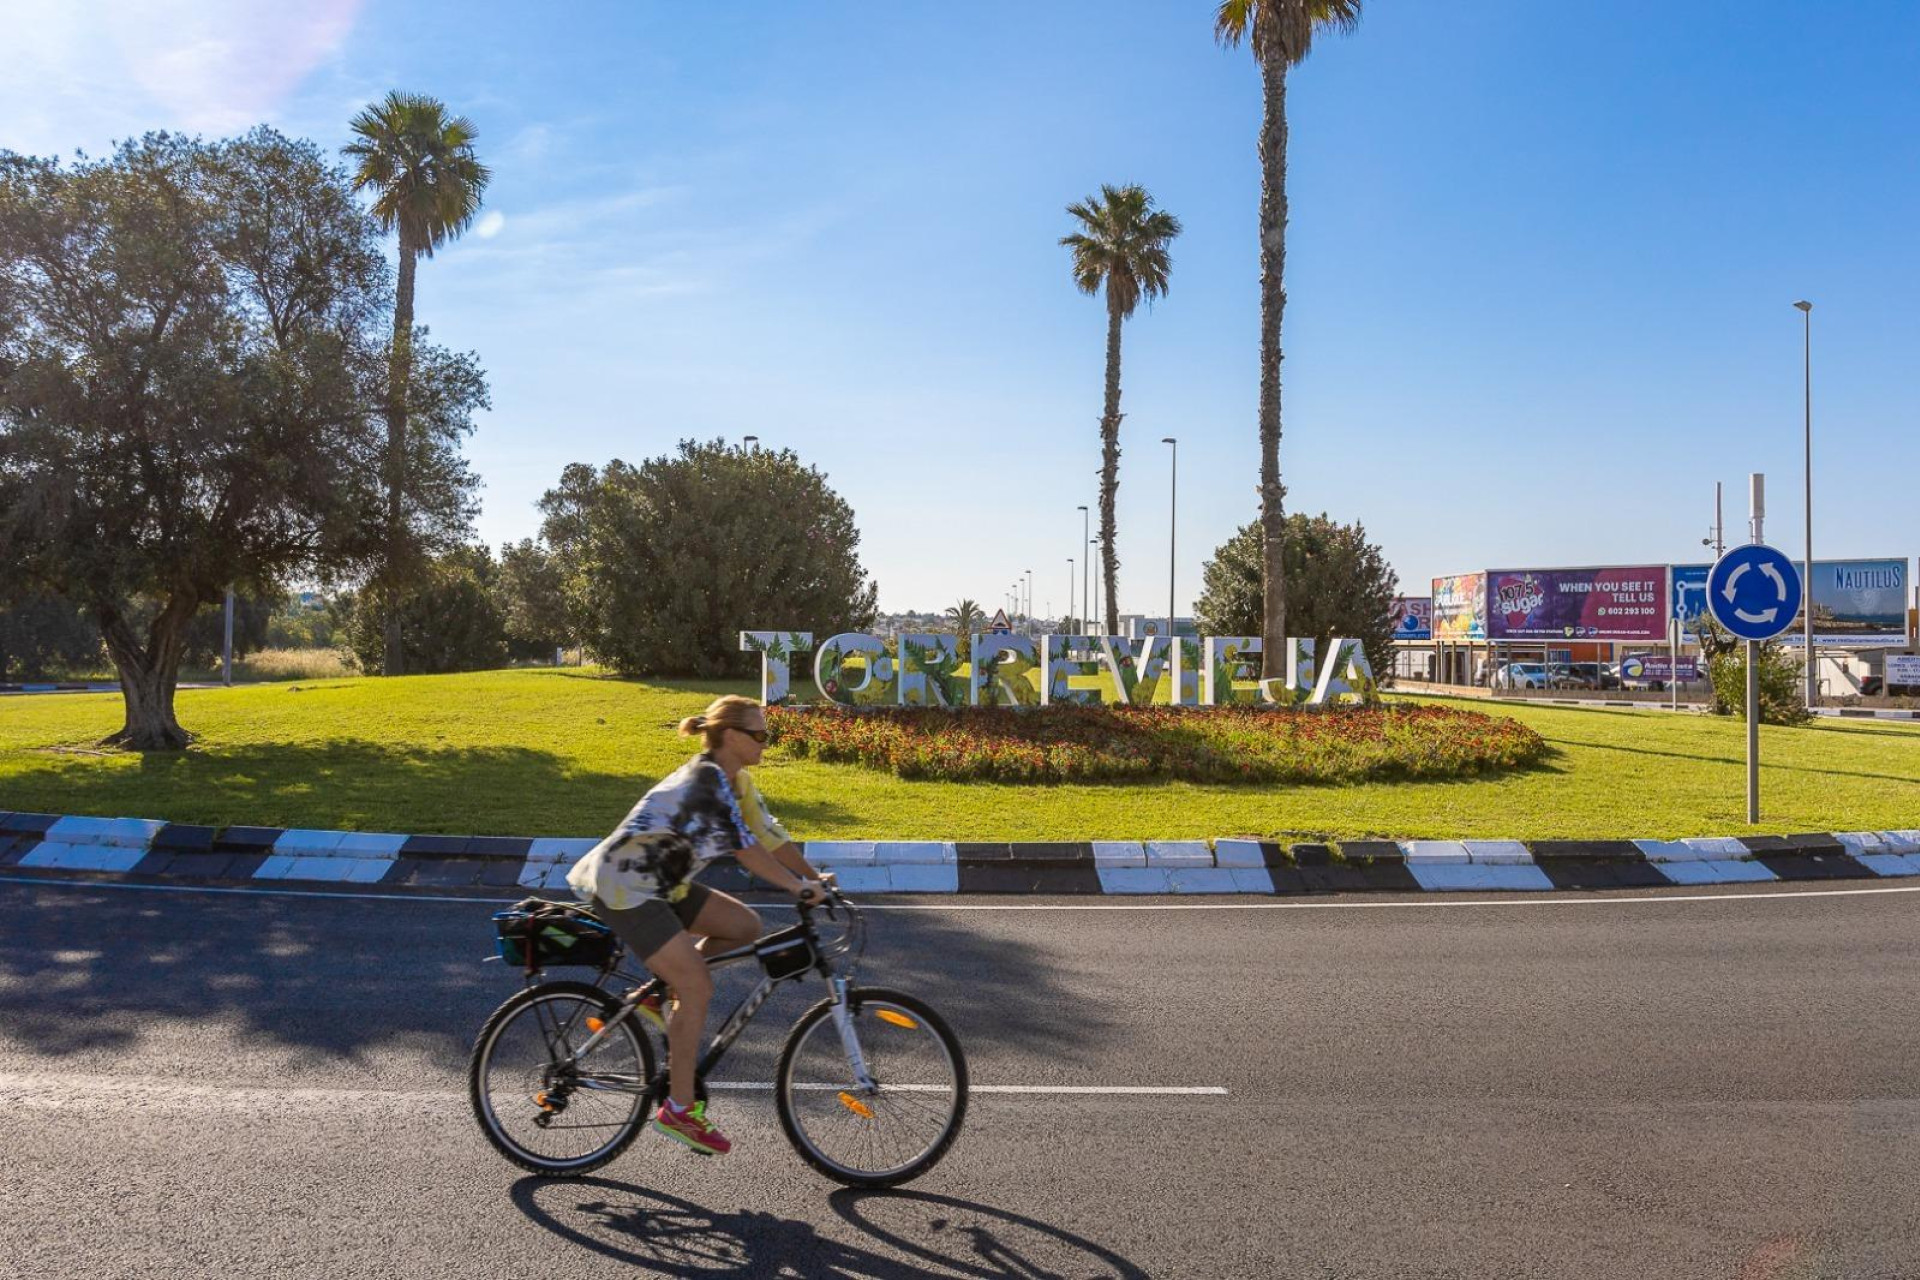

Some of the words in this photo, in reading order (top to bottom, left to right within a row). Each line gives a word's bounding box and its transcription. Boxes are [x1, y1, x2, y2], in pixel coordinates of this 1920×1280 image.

[1836, 566, 1901, 589] NAUTILUS
[1559, 582, 1592, 592] WHEN
[1595, 582, 1618, 592] YOU
[1622, 581, 1641, 591] SEE
[1644, 581, 1654, 591] IT
[1501, 592, 1544, 614] sugar
[1612, 593, 1636, 603] TELL
[1639, 592, 1654, 602] US
[1608, 607, 1623, 615] 602
[1641, 607, 1655, 615] 100
[739, 630, 1380, 706] TORREVIEJA
